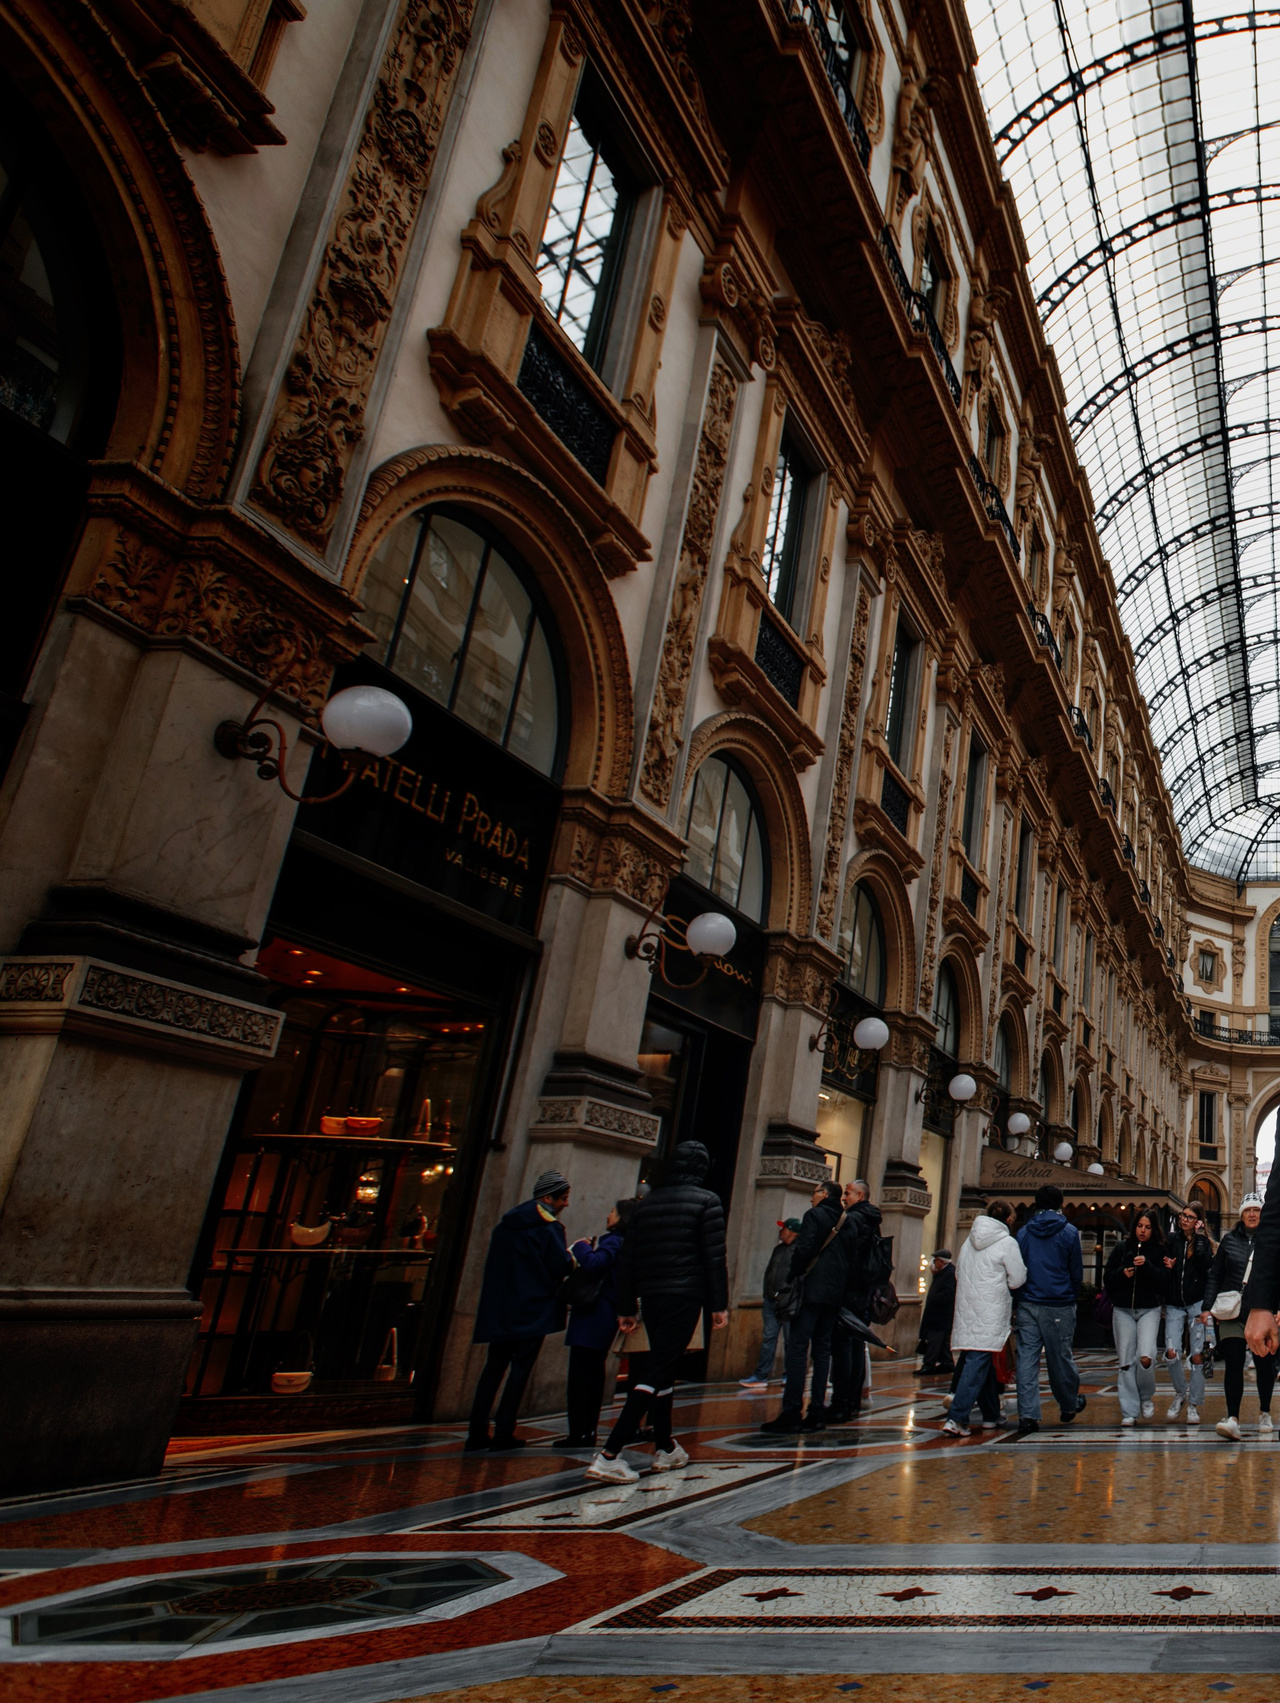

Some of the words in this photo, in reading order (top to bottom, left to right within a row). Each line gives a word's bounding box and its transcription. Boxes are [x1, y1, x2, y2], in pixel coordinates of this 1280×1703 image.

[320, 741, 452, 824] ATELLI
[457, 792, 530, 870] PRADA
[444, 847, 524, 898] VALIGERIE
[992, 1160, 1052, 1178] Galleria
